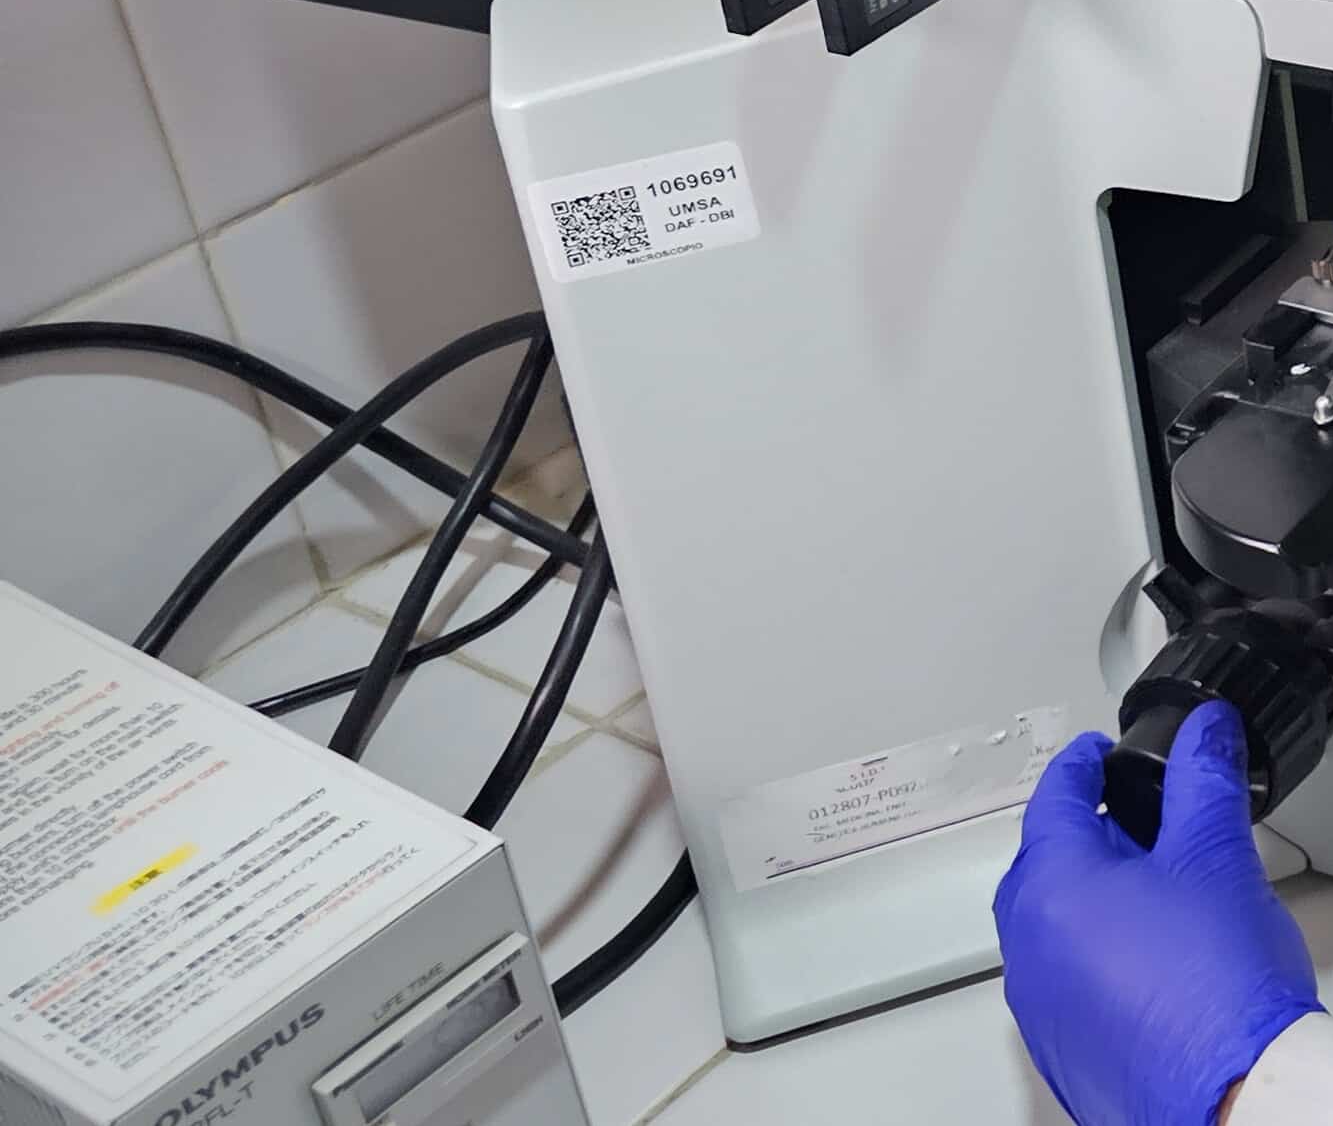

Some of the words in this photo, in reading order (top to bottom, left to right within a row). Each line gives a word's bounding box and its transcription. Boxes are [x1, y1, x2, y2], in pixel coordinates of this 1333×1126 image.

[646, 165, 738, 198] 1069691
[668, 195, 723, 217] UMSA
[664, 217, 695, 234] DAF
[709, 209, 735, 224] DBI
[153, 1002, 324, 1126] OLYMPUS
